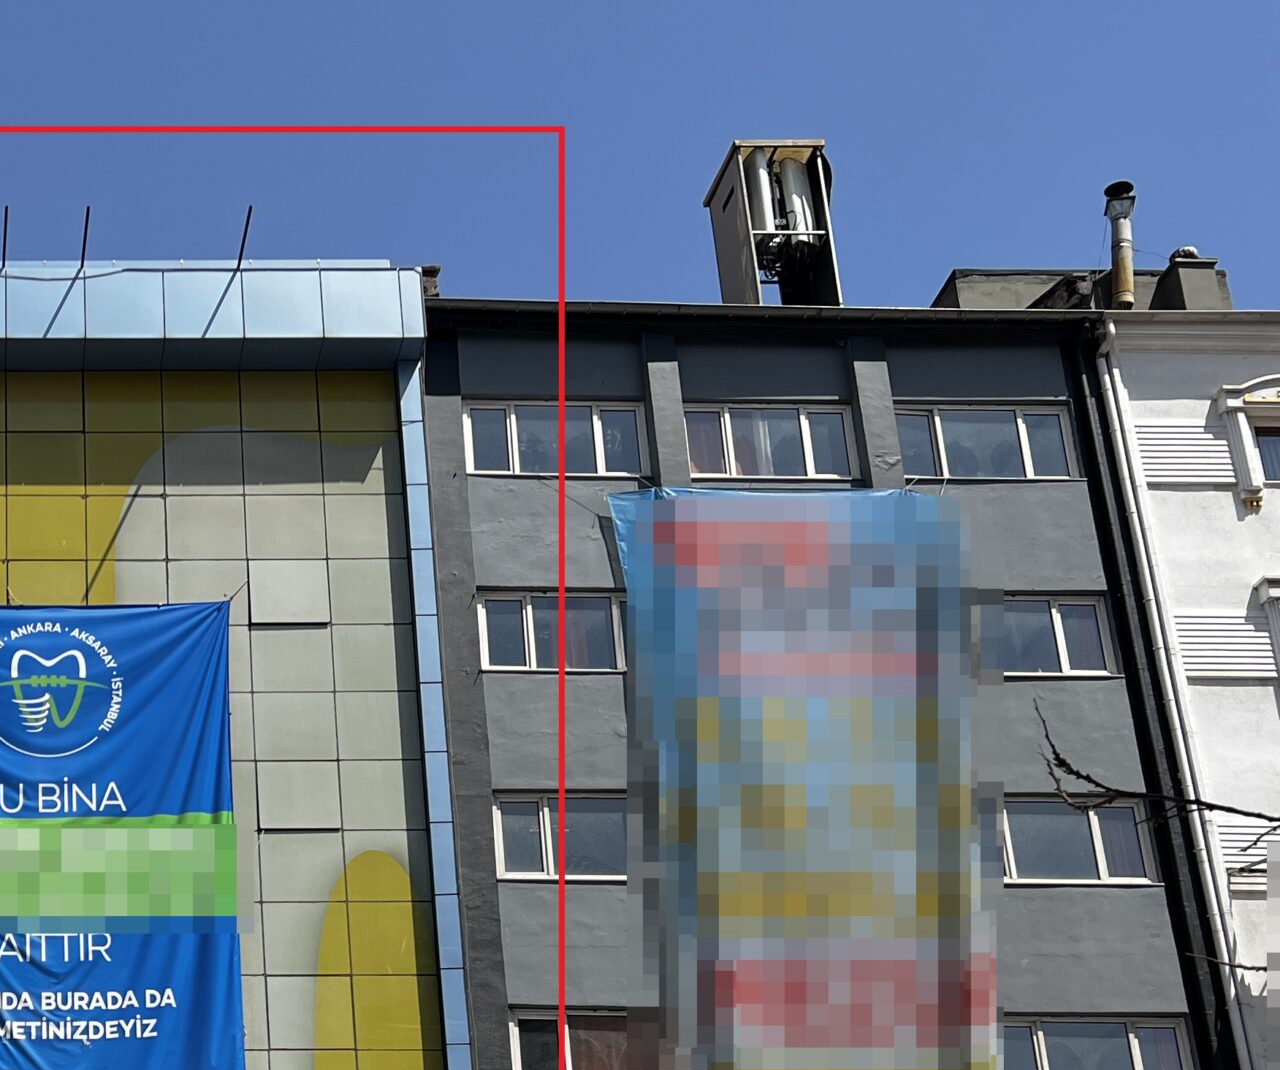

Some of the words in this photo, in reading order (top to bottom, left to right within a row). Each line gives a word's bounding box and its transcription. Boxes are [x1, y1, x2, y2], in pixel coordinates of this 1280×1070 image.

[10, 621, 62, 641] ANKARA
[70, 626, 118, 670] AKSARAY
[99, 677, 124, 732] İSTANBUL
[38, 776, 127, 812] BİNA
[41, 989, 139, 1011] BURADA
[145, 987, 176, 1009] DA
